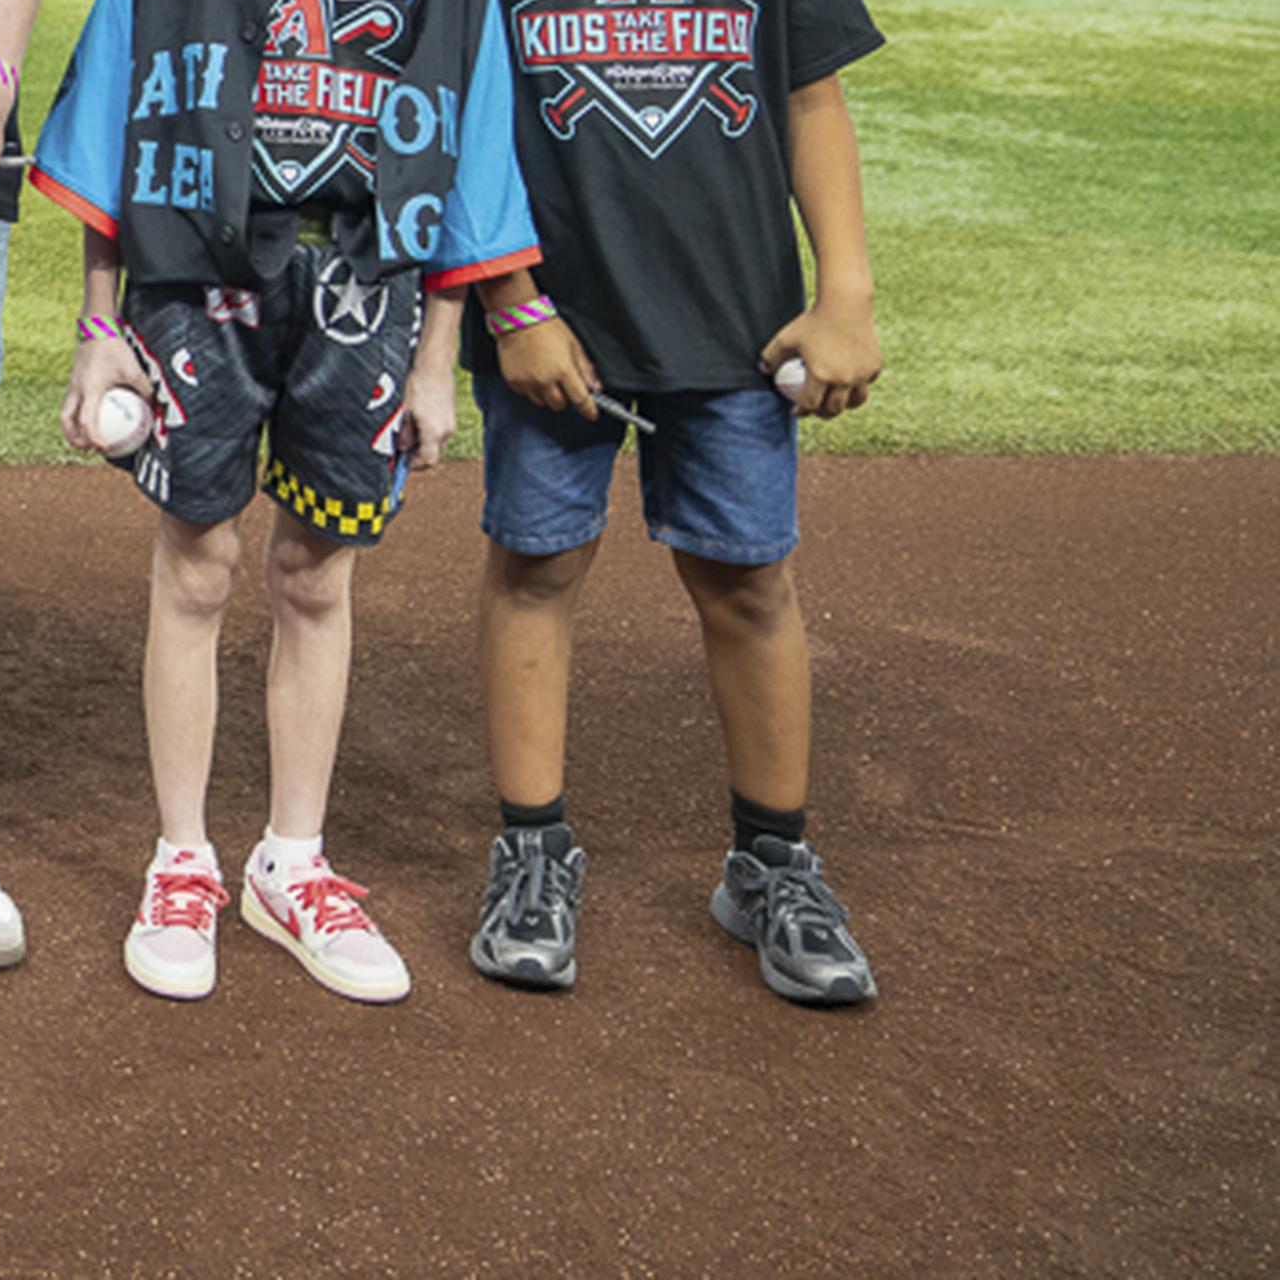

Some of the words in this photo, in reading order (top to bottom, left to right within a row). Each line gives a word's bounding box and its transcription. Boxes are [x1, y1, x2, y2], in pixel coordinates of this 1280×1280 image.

[612, 11, 665, 30] TAKE
[522, 11, 605, 57] KIDS
[612, 31, 668, 53] THE
[263, 64, 311, 81] TAKE
[263, 83, 311, 107] THE
